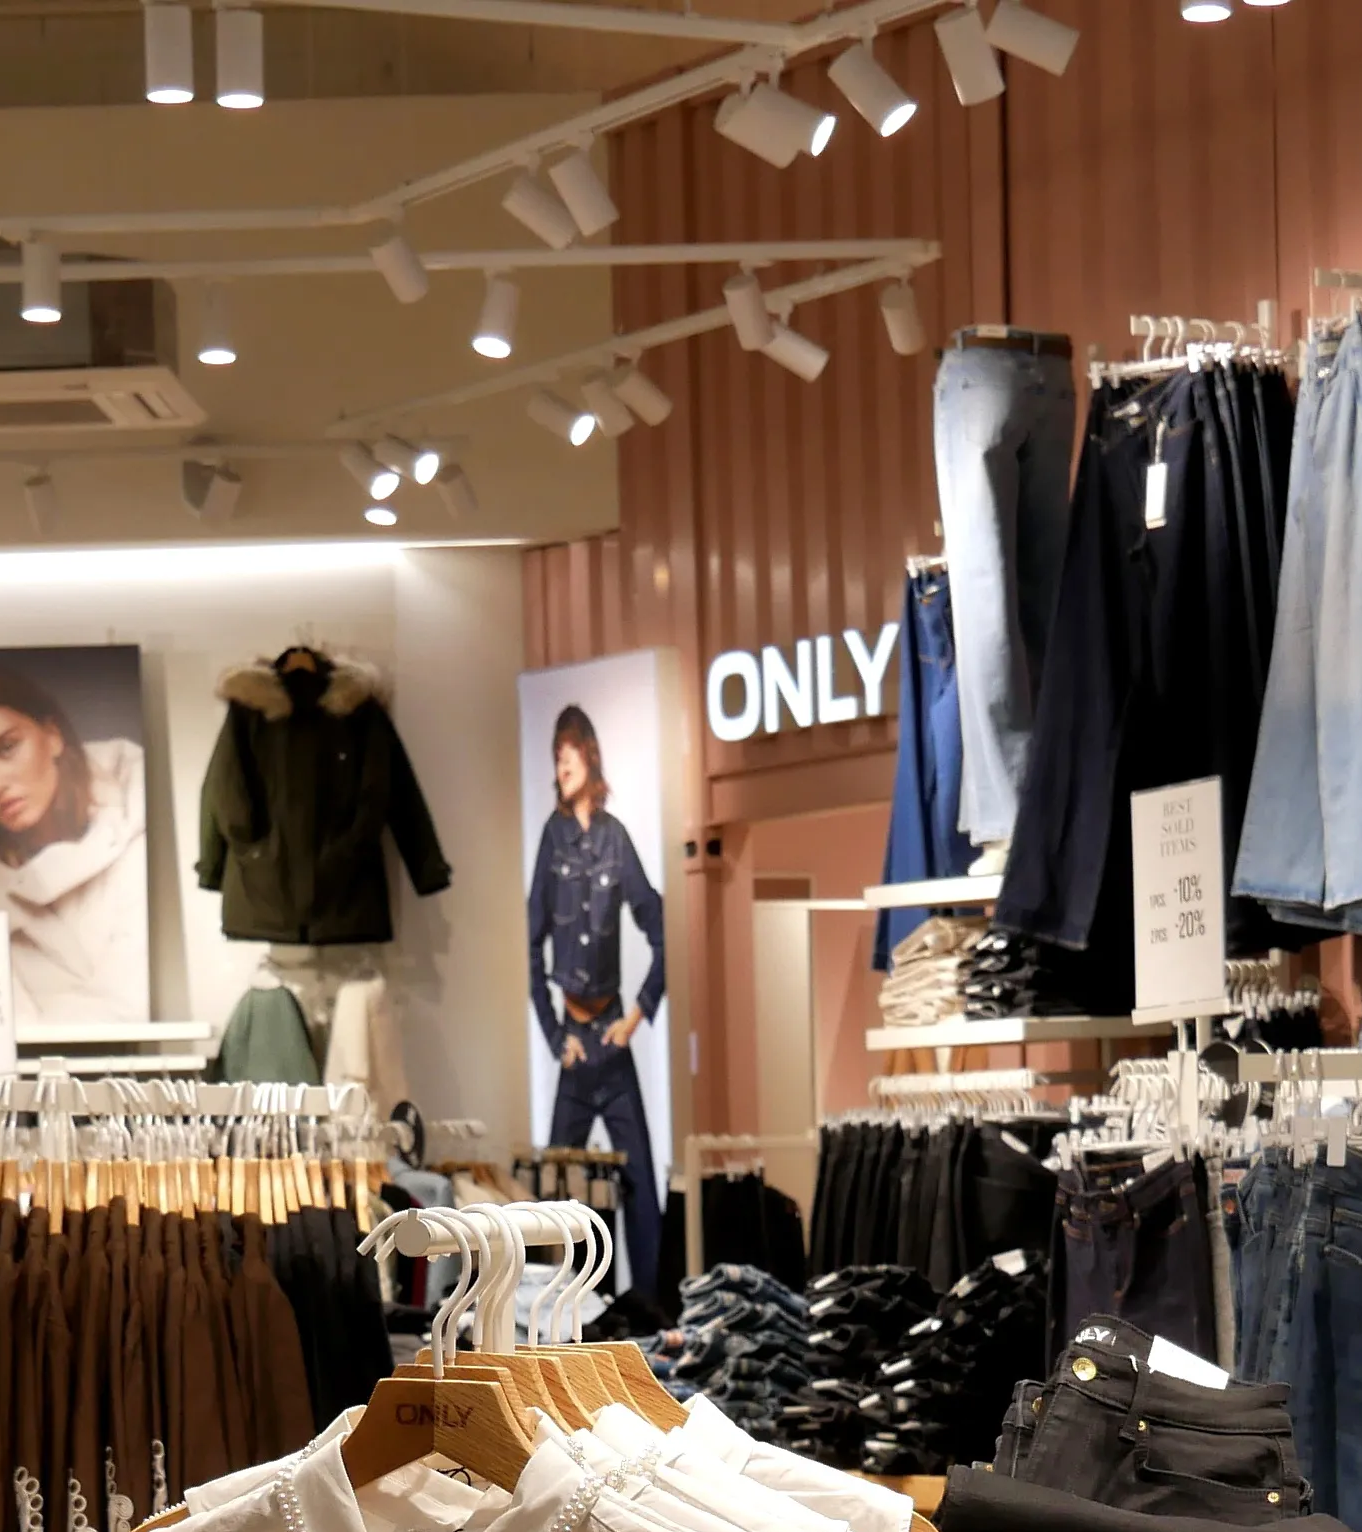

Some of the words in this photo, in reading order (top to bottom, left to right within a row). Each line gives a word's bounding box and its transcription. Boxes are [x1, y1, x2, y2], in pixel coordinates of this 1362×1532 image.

[707, 622, 900, 742] ONLY
[1163, 797, 1193, 817] BEST
[1161, 818, 1194, 837] SOLD
[1159, 838, 1198, 857] ITEMS
[395, 1404, 473, 1429] ONLY
